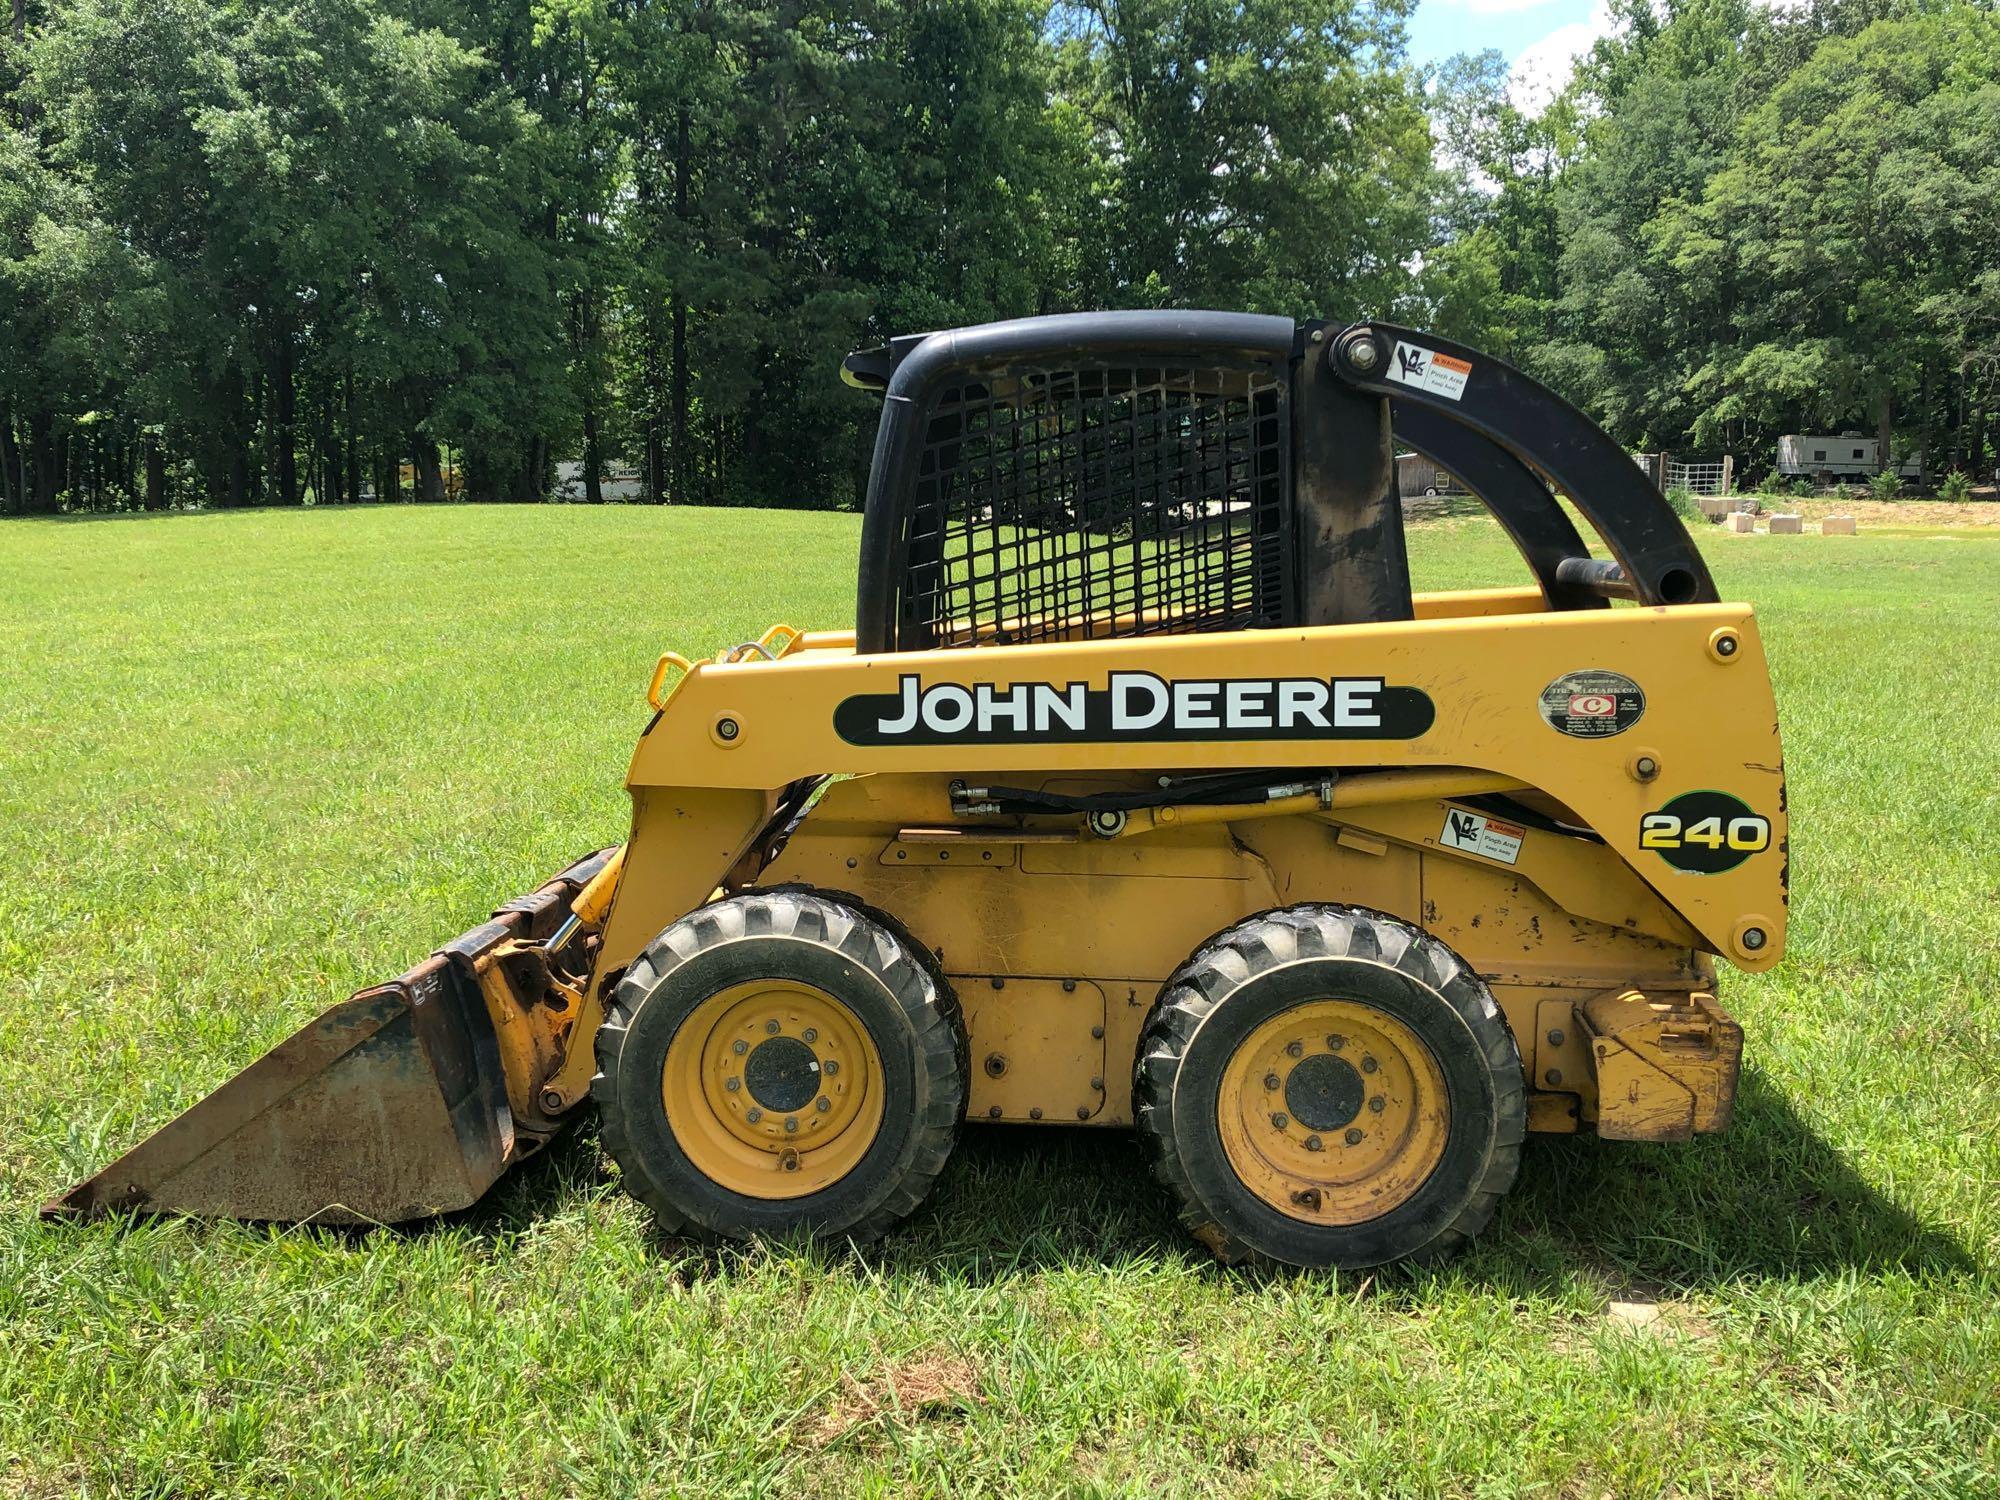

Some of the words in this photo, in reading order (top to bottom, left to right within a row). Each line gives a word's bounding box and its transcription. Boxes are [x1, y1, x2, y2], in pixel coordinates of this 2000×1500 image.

[1431, 370, 1448, 380] Pinch
[878, 676, 1086, 733] JOHN
[1111, 674, 1382, 731] DEERE
[1484, 835, 1502, 845] Pinch
[1502, 841, 1517, 849] Area
[1642, 815, 1769, 850] 240
